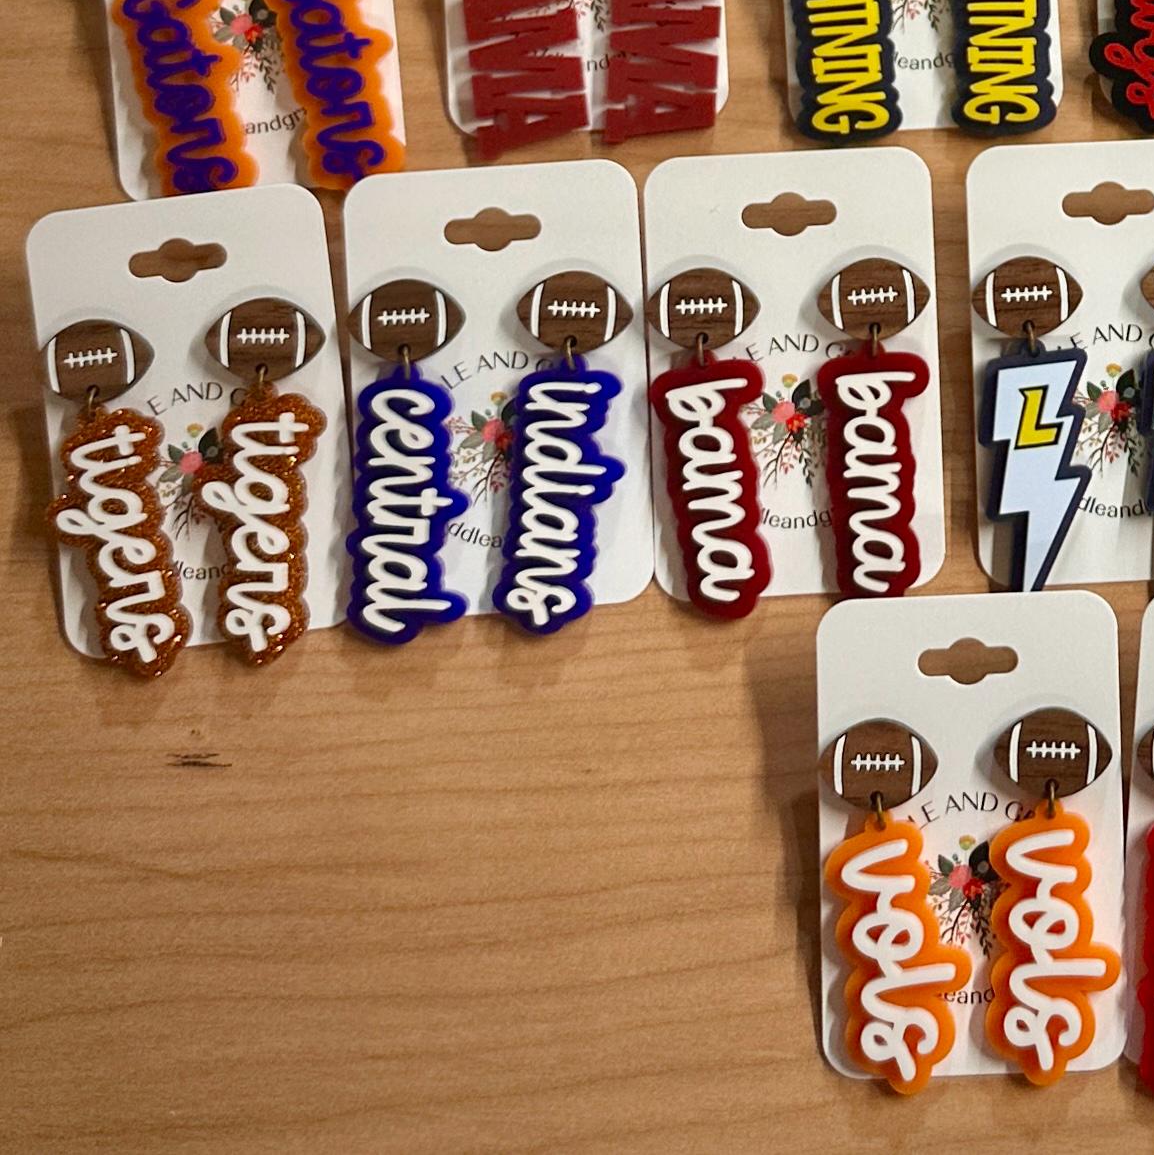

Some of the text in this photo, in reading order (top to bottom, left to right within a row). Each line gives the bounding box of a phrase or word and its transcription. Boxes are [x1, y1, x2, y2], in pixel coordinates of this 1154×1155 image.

[170, 381, 224, 405] AND
[476, 350, 530, 373] AND
[767, 332, 820, 356] AND
[1014, 384, 1063, 451] L
[1092, 322, 1143, 346] AND
[56, 424, 176, 664] tigers
[201, 411, 311, 653] tigers
[361, 388, 454, 633] central
[506, 382, 608, 627] indians
[665, 376, 755, 603] bama
[835, 371, 917, 594] bama
[944, 791, 999, 814] AND
[840, 838, 957, 1082] vols
[1003, 828, 1108, 1072] vols
